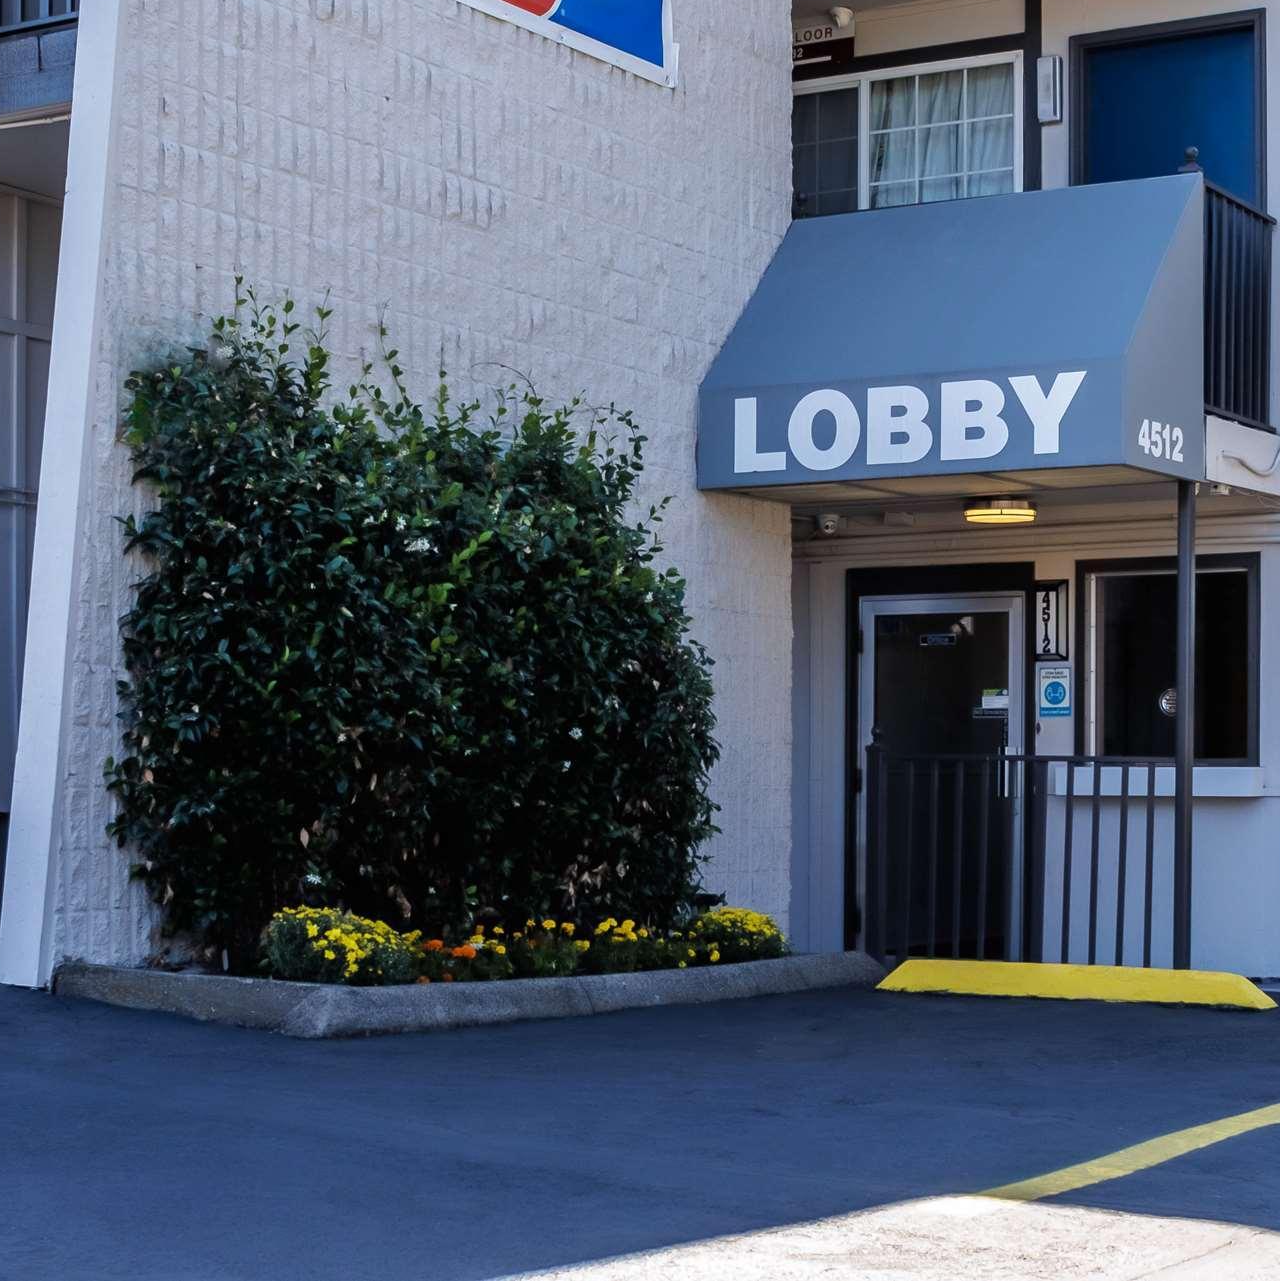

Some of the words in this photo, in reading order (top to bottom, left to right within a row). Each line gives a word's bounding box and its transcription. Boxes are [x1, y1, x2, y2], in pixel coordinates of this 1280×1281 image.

[795, 27, 832, 44] LOOR
[733, 370, 1087, 474] LOBBY
[1138, 419, 1183, 462] 4512
[1042, 591, 1050, 653] 4512
